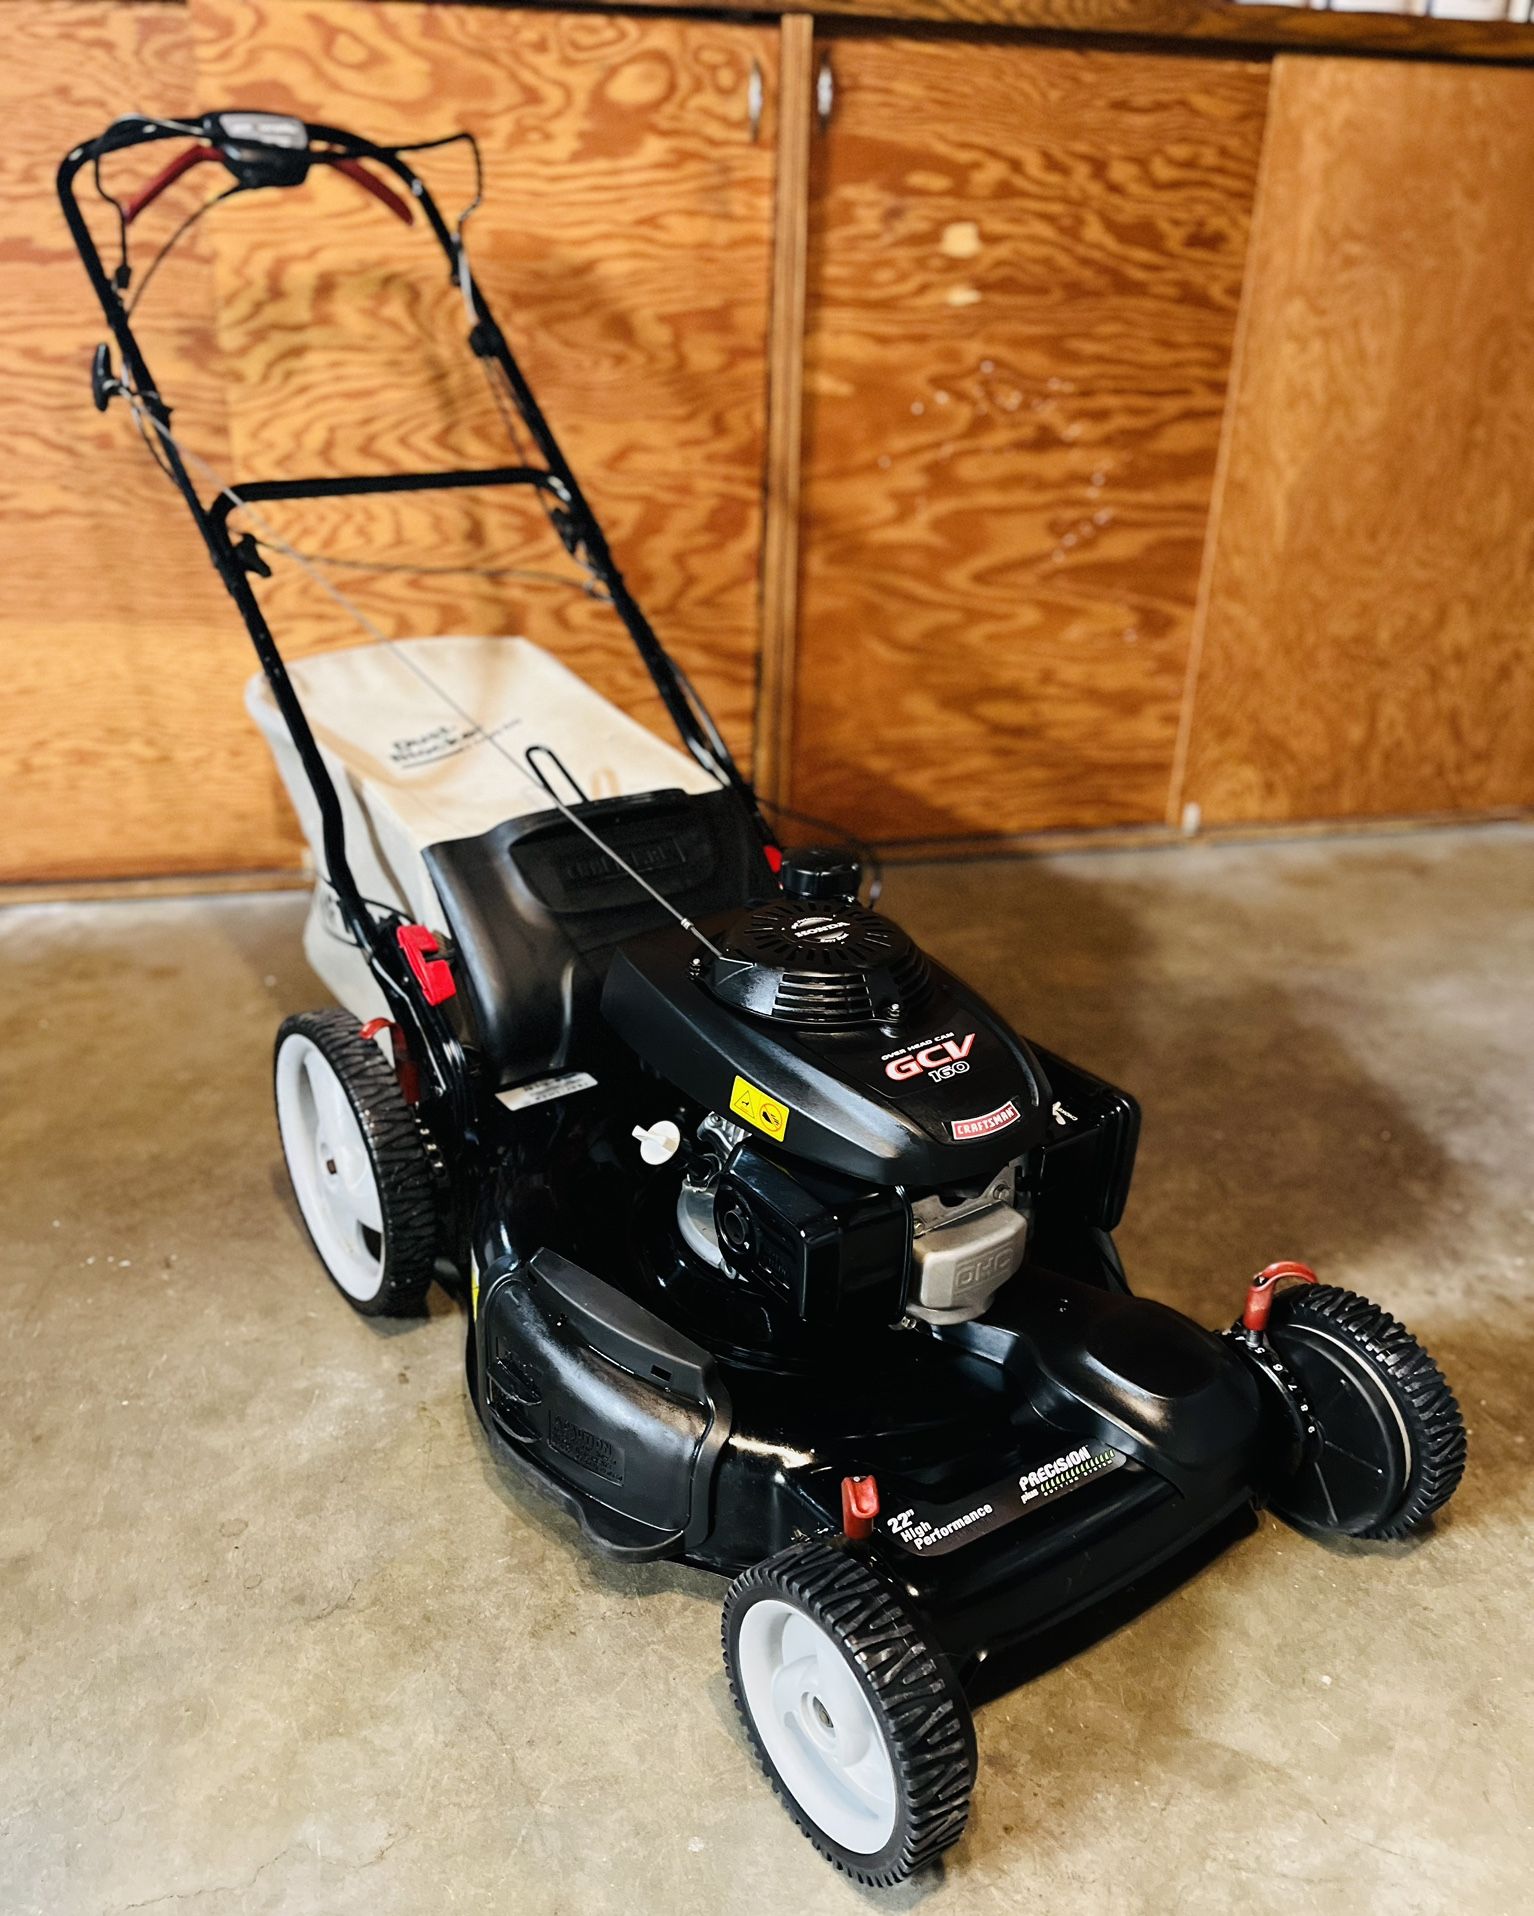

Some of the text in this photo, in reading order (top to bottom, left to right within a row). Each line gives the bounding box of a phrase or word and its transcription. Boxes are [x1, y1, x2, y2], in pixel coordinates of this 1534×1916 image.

[880, 1031, 955, 1061] OVER HEAD CAM
[885, 1032, 976, 1081] GCV
[927, 1060, 970, 1083] 160
[957, 1107, 1015, 1135] CRAFTSMAN
[1019, 1446, 1092, 1491] PRECISION
[1020, 1488, 1039, 1505] plus
[887, 1508, 915, 1534] 22"
[900, 1521, 932, 1543] High
[913, 1503, 993, 1551] Performance
